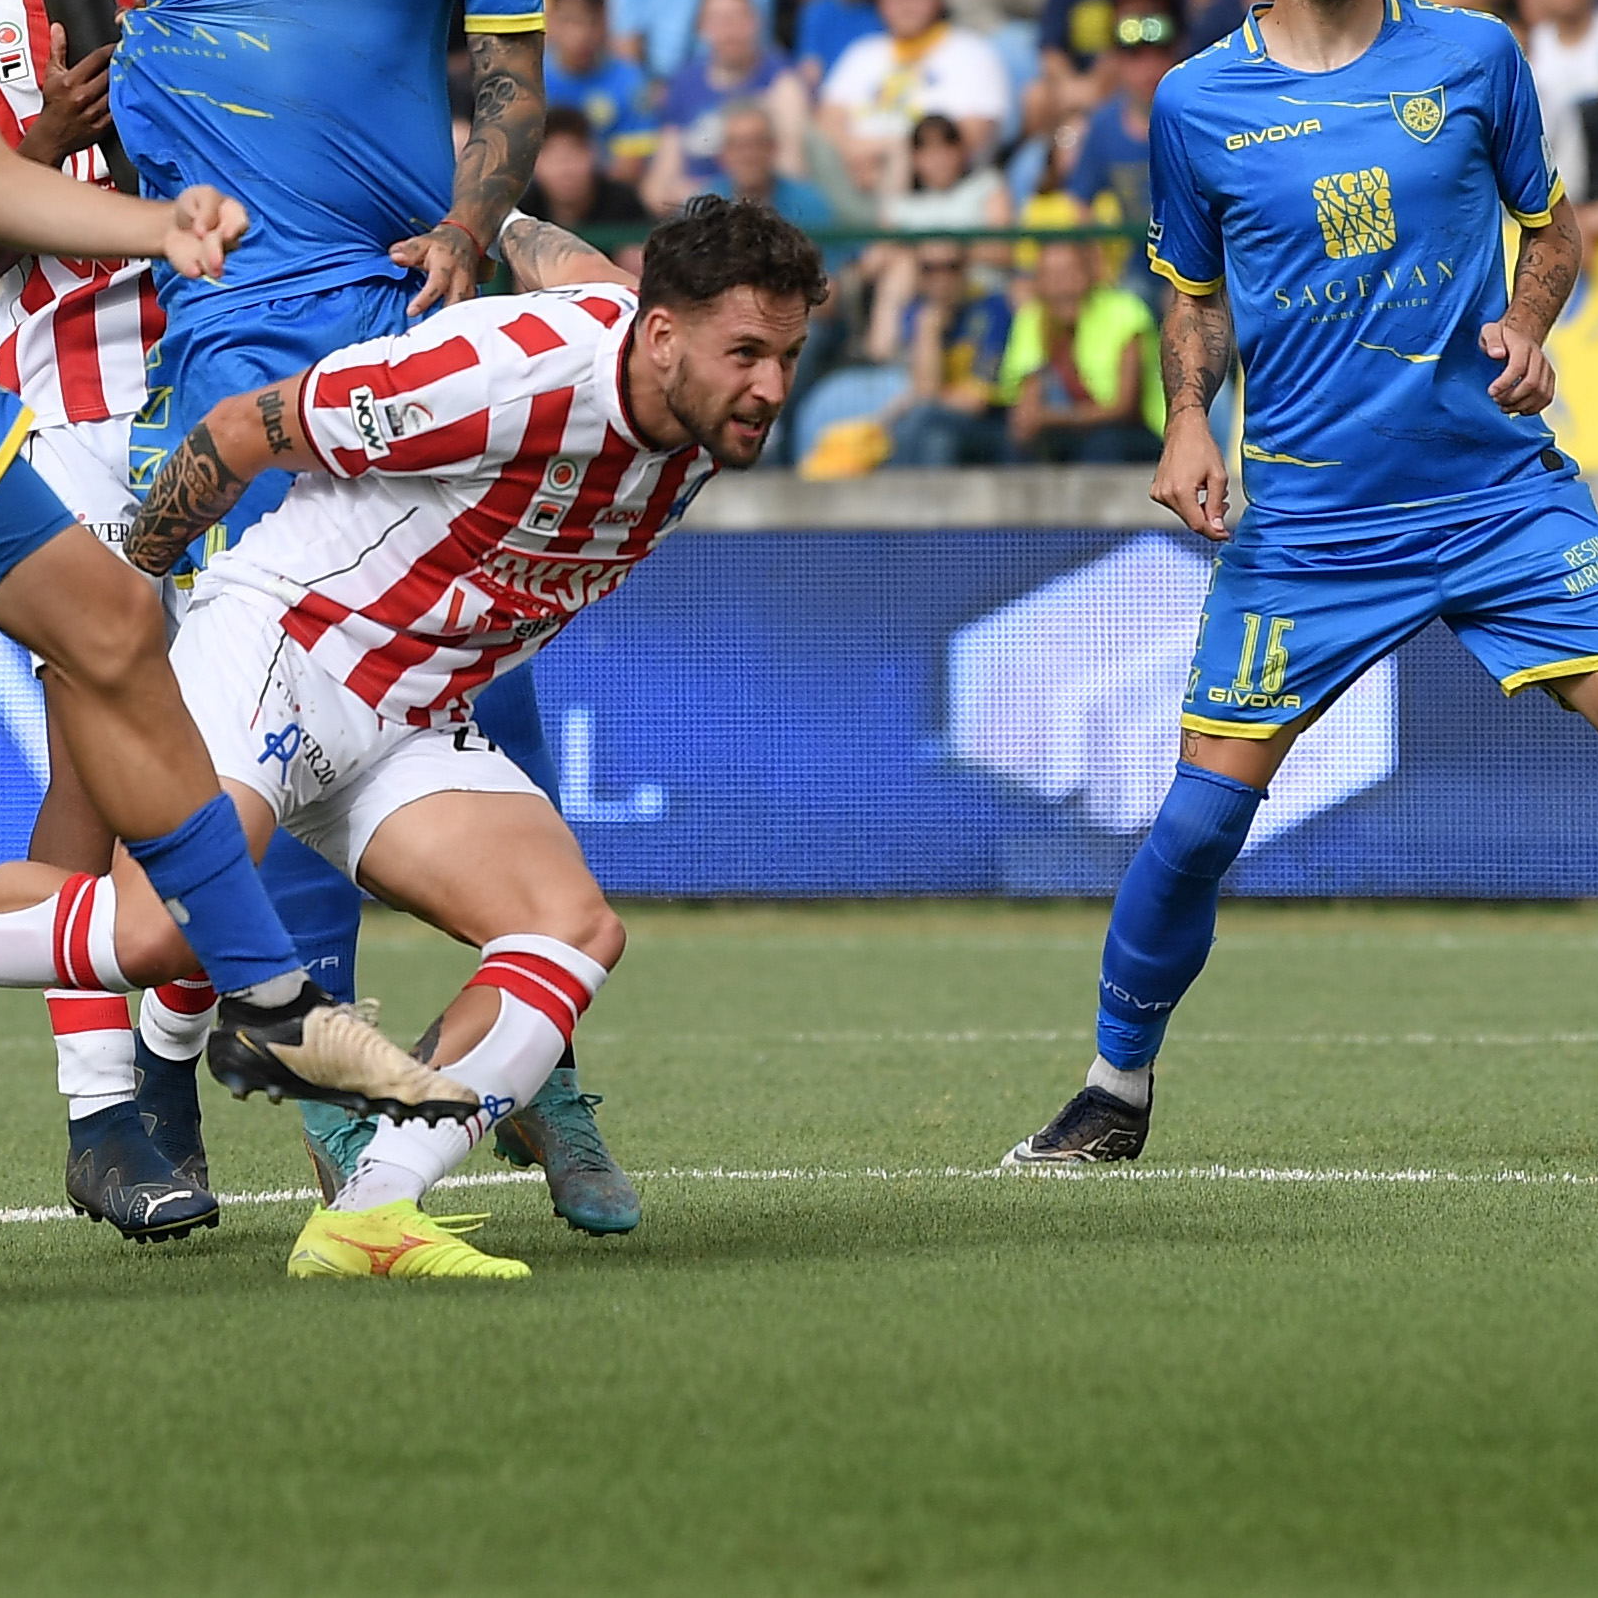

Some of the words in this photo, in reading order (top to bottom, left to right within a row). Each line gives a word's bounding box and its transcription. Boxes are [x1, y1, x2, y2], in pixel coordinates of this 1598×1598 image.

[1225, 118, 1322, 151] GIVOVA
[1274, 258, 1455, 311] SAGEVAN
[355, 391, 384, 450] NOW
[1232, 612, 1295, 694] 15
[1208, 687, 1301, 709] GIVOVA
